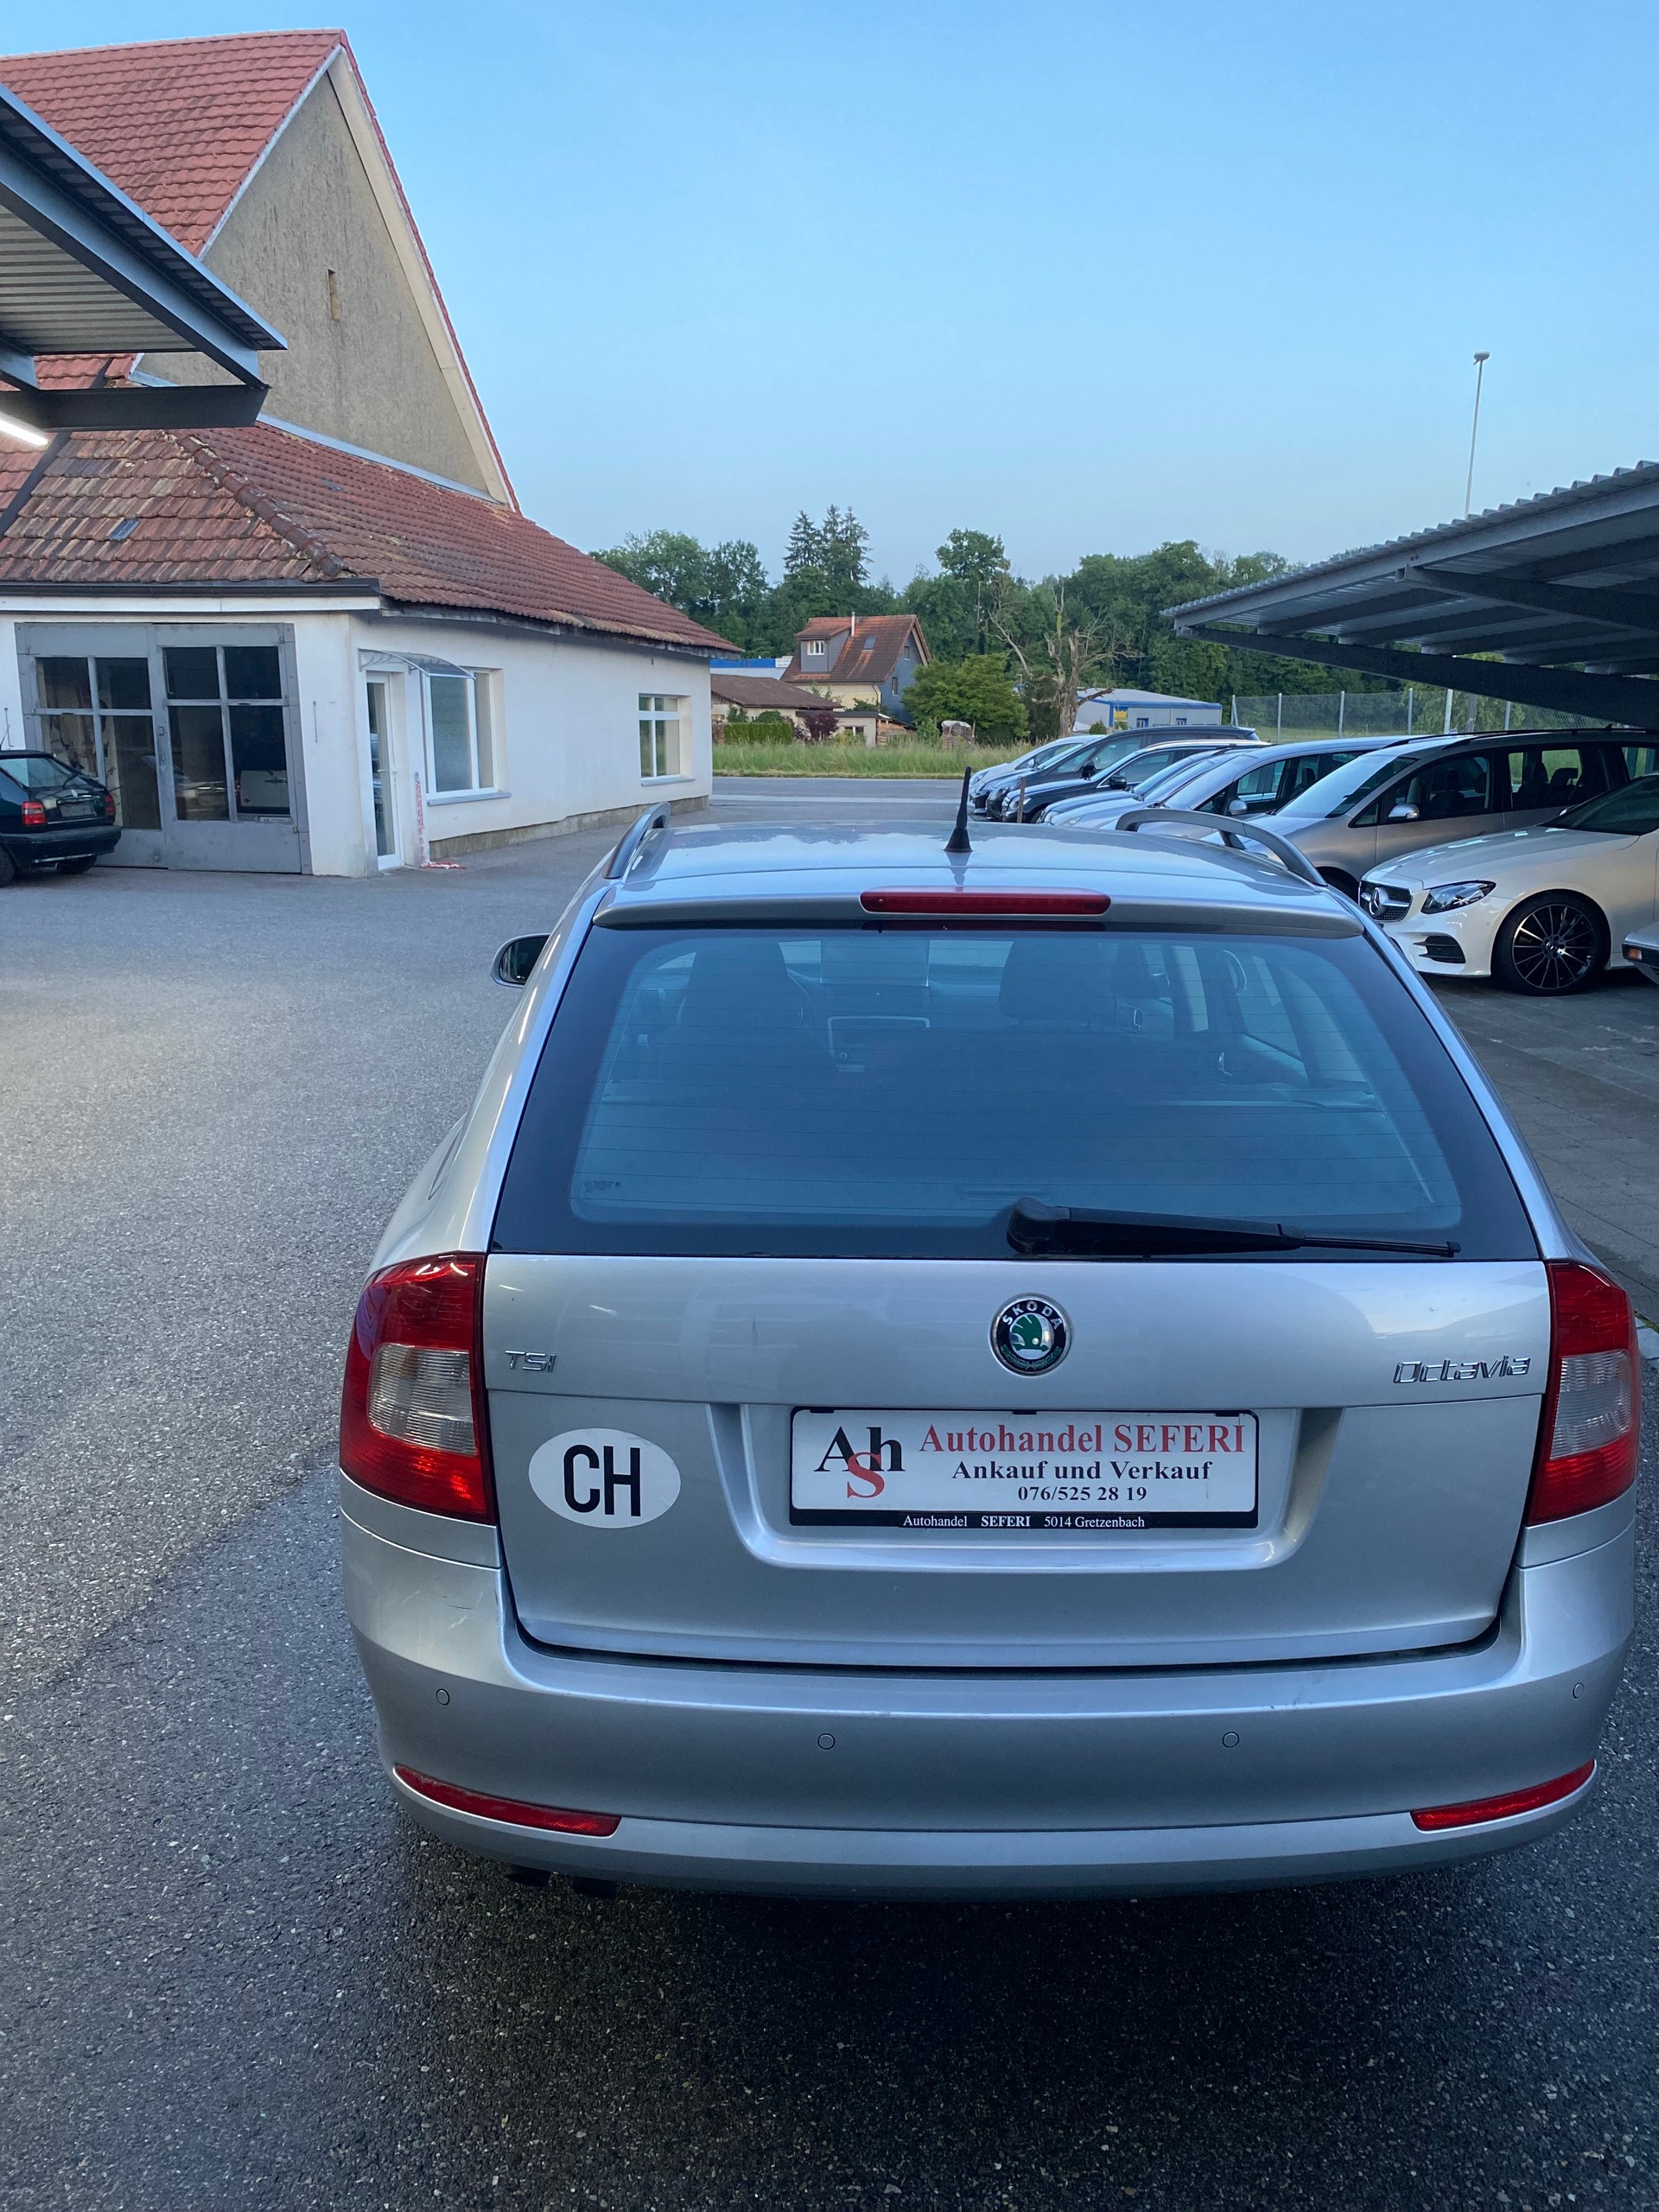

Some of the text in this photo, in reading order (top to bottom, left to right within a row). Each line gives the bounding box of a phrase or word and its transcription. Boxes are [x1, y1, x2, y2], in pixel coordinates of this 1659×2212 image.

[505, 1350, 557, 1372] TSI
[1393, 1354, 1531, 1383] Octavia
[918, 1424, 1245, 1453] Autohandel SEFERI
[563, 1444, 641, 1517] CH
[951, 1460, 1213, 1480] Ankauf und Verkauf
[1018, 1485, 1147, 1501] 076/525 28 19
[903, 1515, 1145, 1528] Autohandel SEFERI 5014 Gretzenbach
